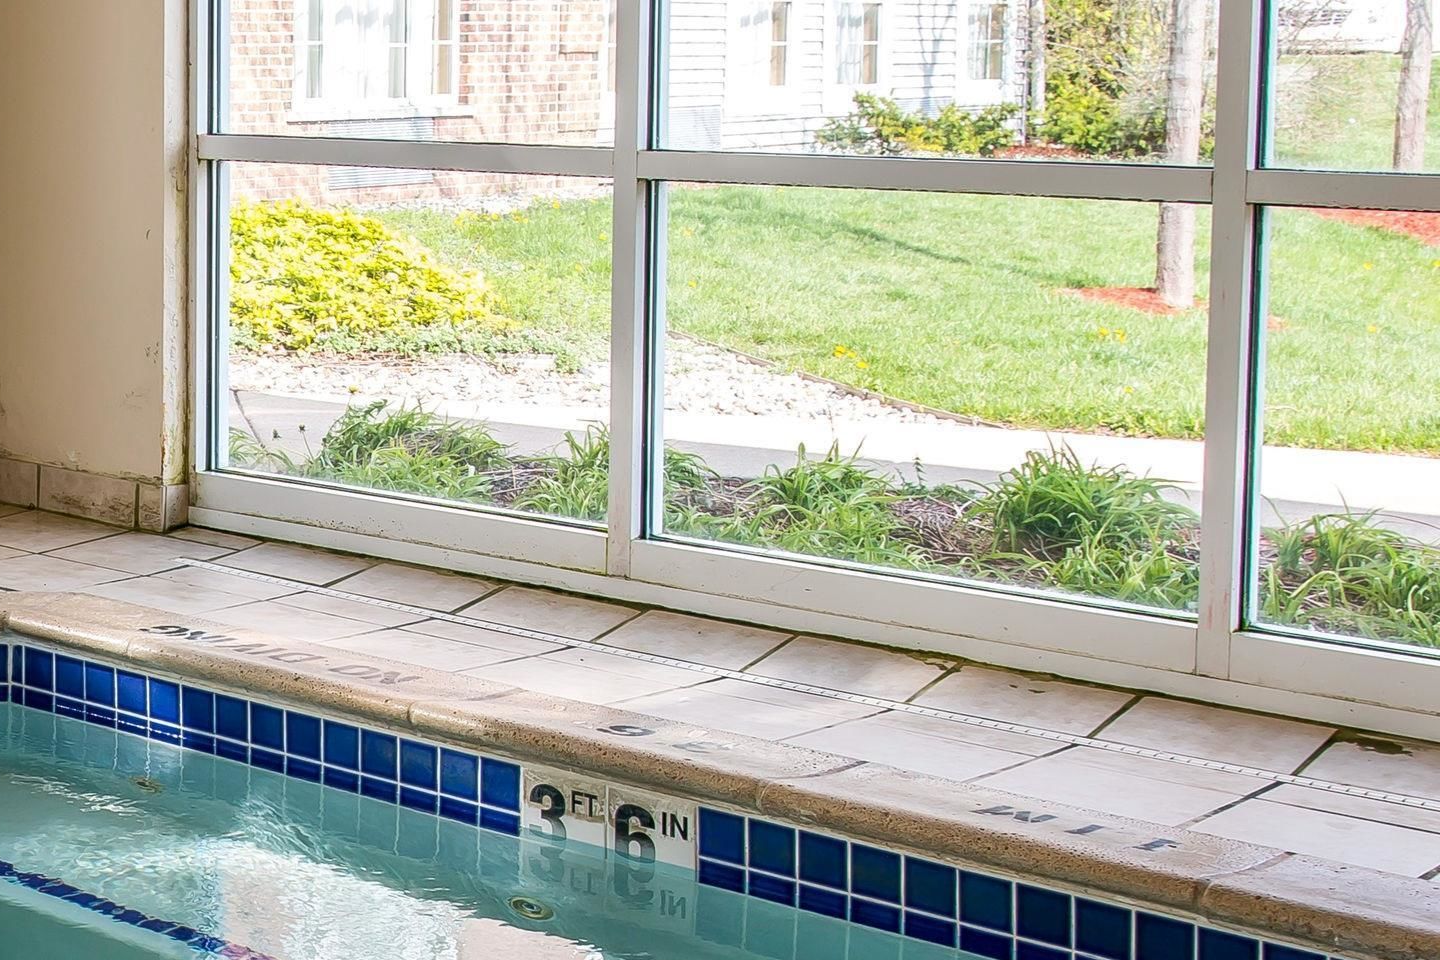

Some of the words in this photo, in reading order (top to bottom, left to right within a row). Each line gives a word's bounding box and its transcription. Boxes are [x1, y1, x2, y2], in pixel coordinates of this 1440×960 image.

[571, 789, 597, 818] FT
[615, 803, 656, 864] 6
[661, 811, 688, 841] IN
